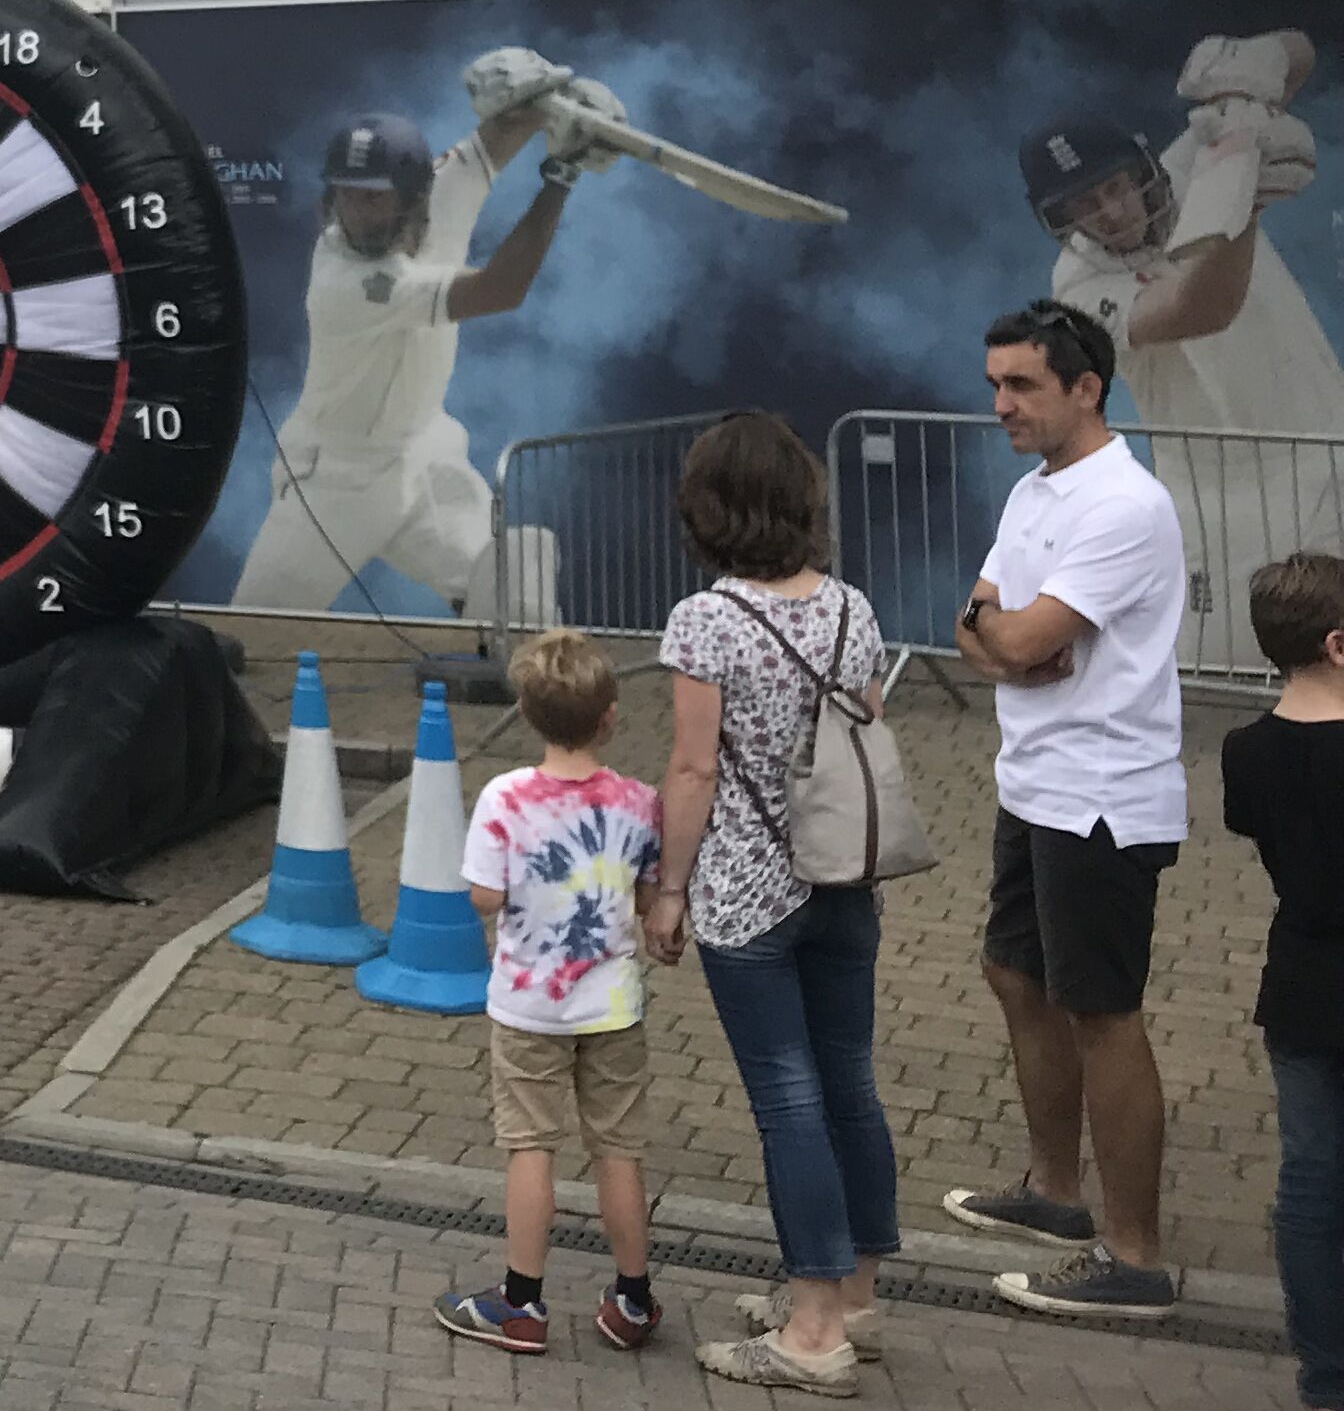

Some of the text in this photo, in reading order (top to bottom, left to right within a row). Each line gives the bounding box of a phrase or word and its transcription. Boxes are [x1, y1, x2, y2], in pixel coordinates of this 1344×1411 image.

[78, 102, 104, 135] 4
[214, 161, 284, 182] GHAN
[120, 196, 167, 231] 13
[154, 302, 180, 338] 6
[134, 405, 182, 442] 10
[94, 502, 143, 540] 15
[38, 578, 66, 613] 2
